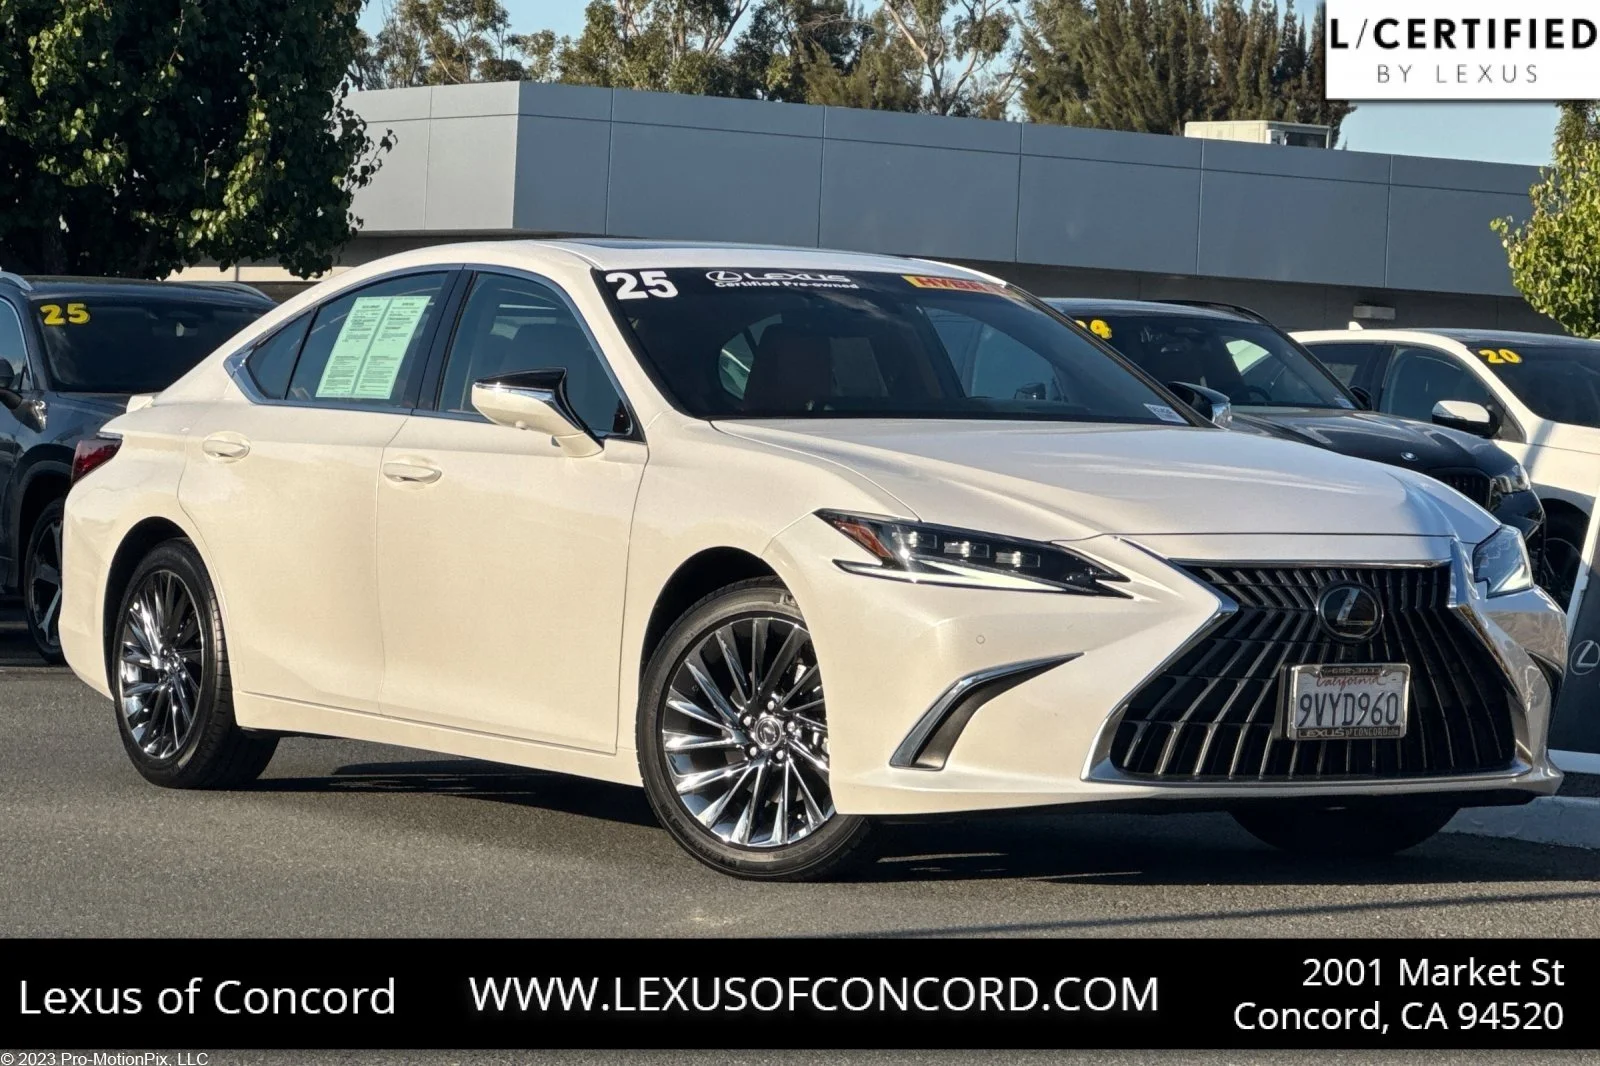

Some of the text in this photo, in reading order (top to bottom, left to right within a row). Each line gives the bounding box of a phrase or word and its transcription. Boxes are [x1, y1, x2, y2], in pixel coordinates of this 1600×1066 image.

[605, 270, 679, 300] 25
[714, 280, 860, 289] Certified Pre-owned
[744, 272, 851, 283] LEXUS
[914, 276, 1016, 296] HYBR
[40, 303, 91, 325] 25
[1075, 319, 1113, 340] 4
[1479, 348, 1523, 364] 20
[1298, 692, 1399, 727] 9VYD960
[1299, 728, 1345, 738] LEXUS
